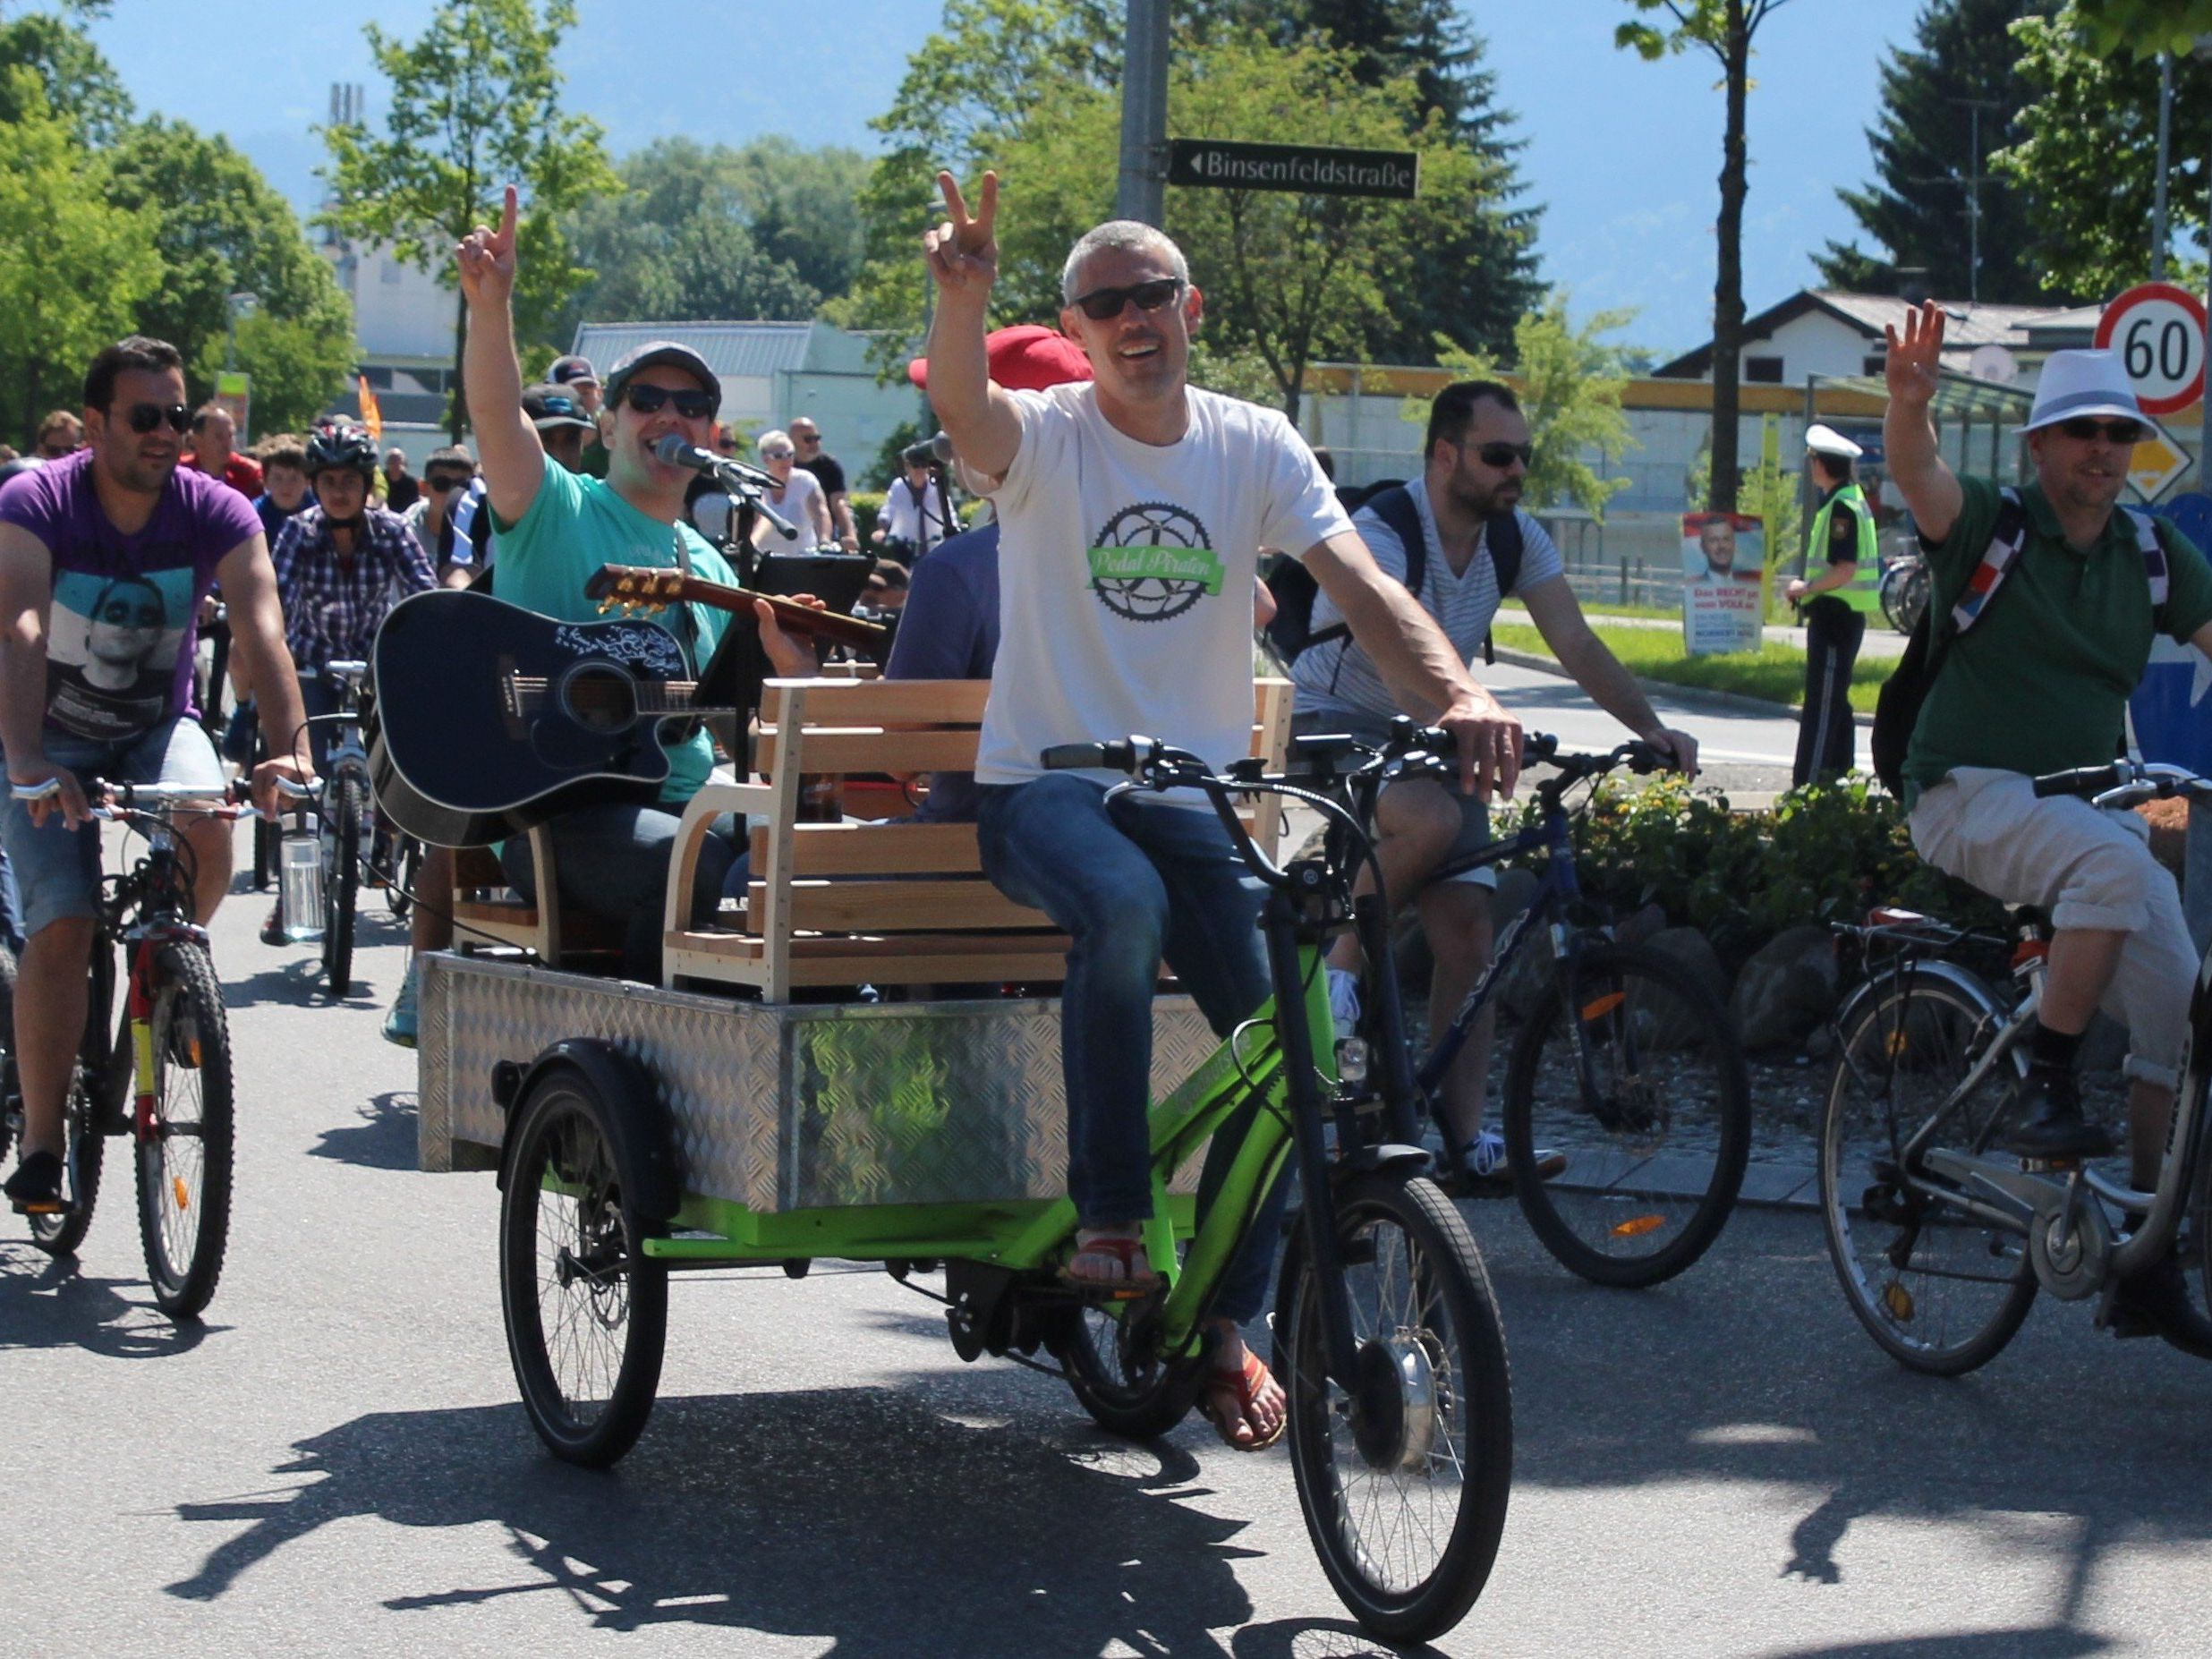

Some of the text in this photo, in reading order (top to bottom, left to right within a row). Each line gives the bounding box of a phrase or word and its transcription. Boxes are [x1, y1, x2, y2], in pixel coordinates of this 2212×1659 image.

[1206, 150, 1411, 189] Binsenfeldstraße
[2124, 318, 2190, 381] 60
[1093, 549, 1211, 575] Pedal Piraten
